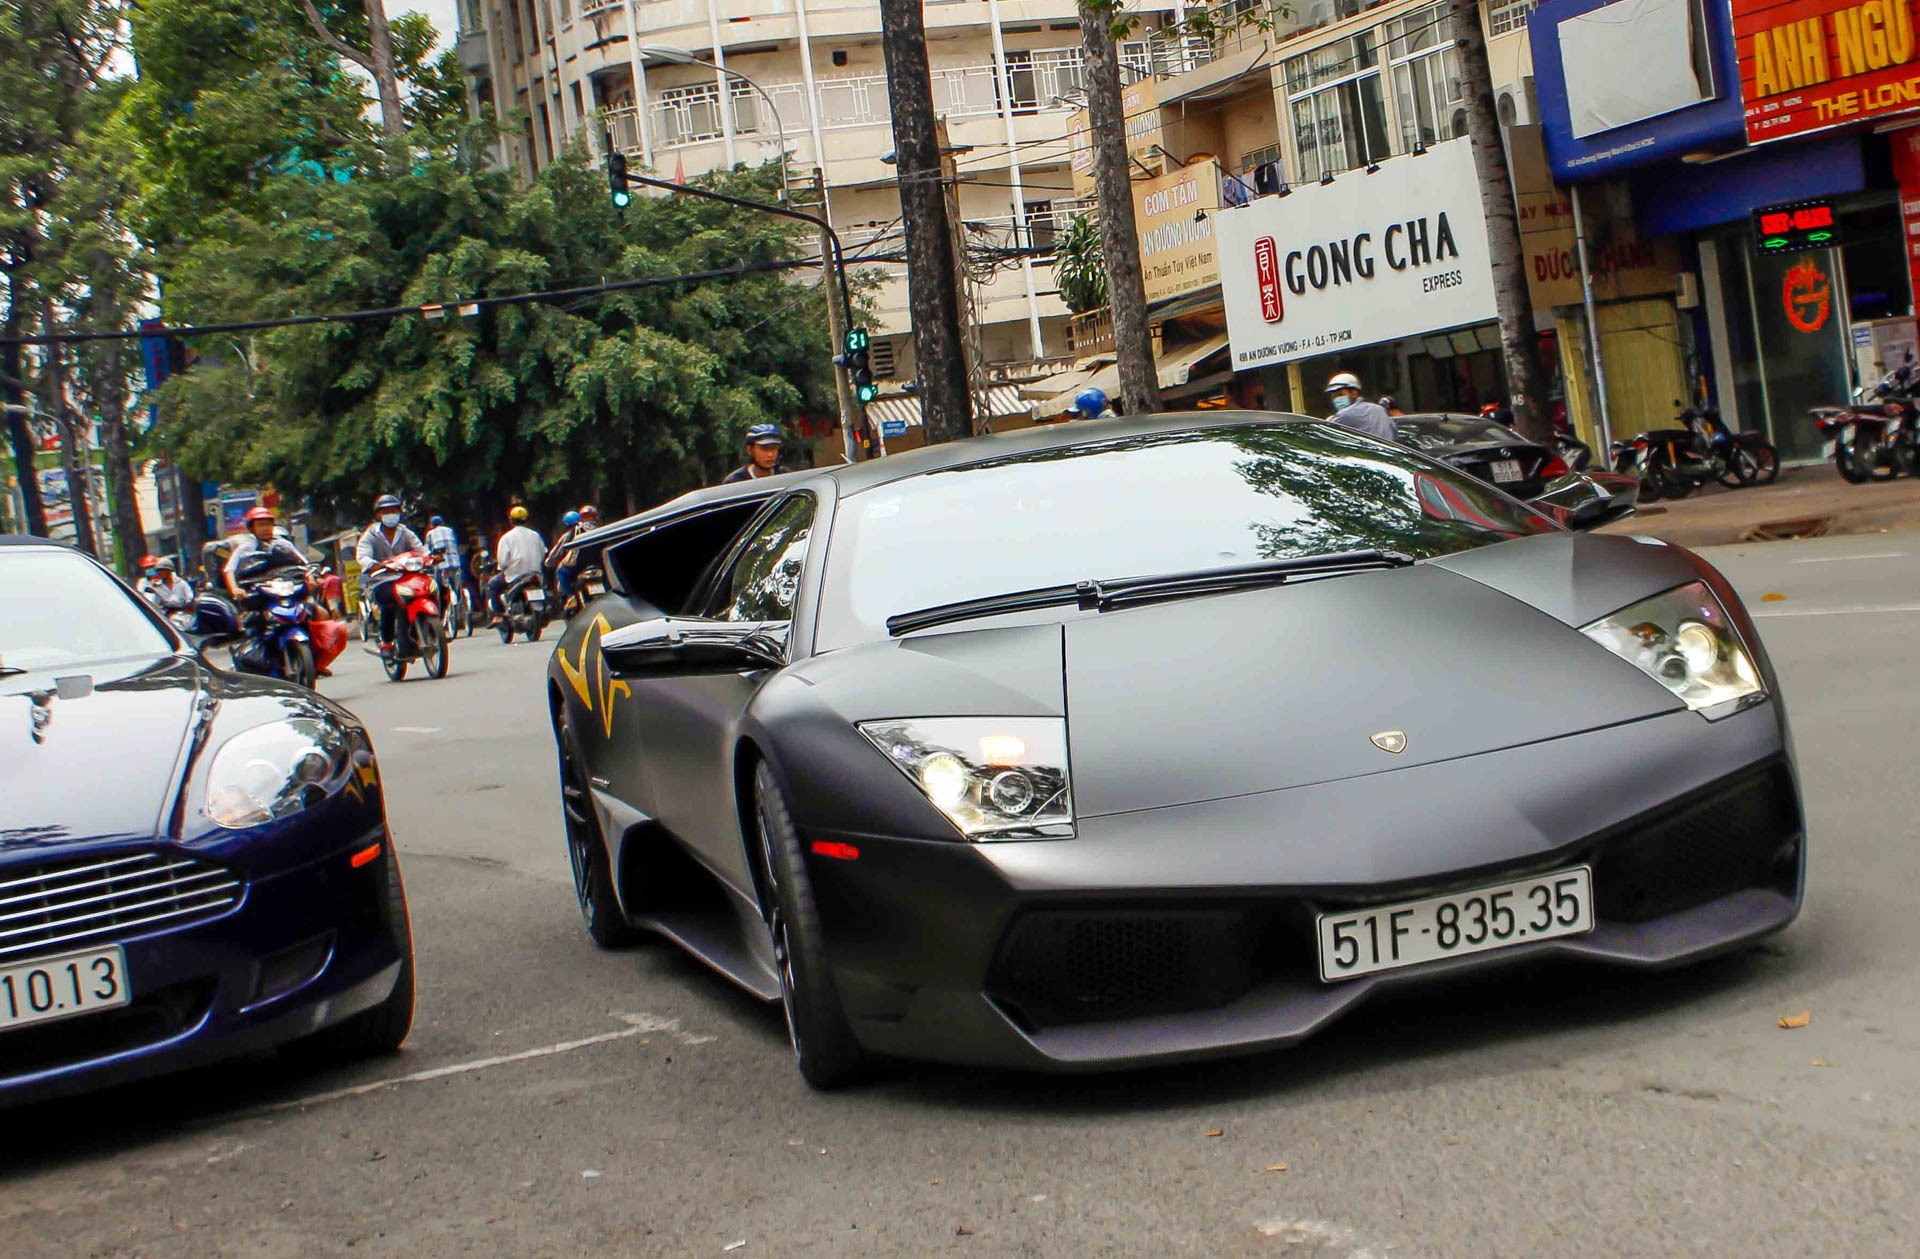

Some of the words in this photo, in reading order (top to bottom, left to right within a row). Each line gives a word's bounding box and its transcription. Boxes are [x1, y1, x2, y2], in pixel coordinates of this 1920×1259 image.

[1754, 16, 1829, 98] ANH
[1812, 92, 1859, 121] THE
[1144, 190, 1170, 217] CƠM
[1171, 175, 1199, 209] TẤM
[1285, 232, 1375, 296] GONG
[1384, 211, 1460, 272] CHA
[1423, 270, 1463, 294] EXPRESS
[849, 333, 866, 350] 21
[1332, 877, 1580, 970] 51F-835.35
